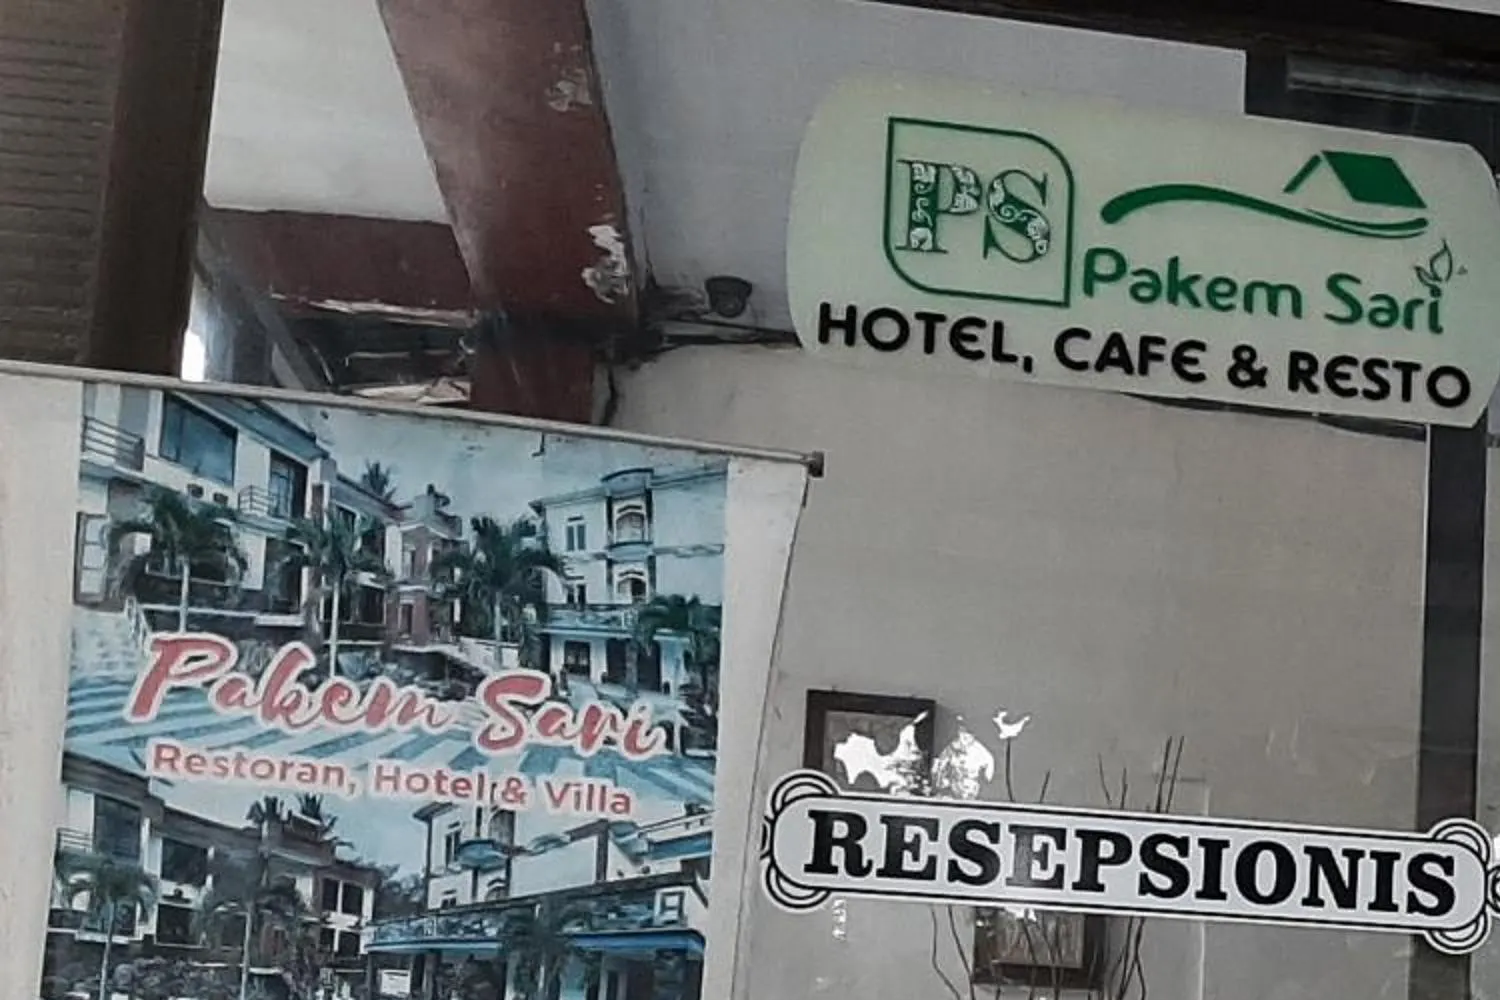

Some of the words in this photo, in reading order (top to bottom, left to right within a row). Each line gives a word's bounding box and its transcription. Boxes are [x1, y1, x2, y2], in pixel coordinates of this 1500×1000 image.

[895, 158, 1052, 263] PS
[1083, 247, 1303, 319] Pakem
[1324, 271, 1445, 335] Sari
[819, 300, 1036, 373] HOTEL,
[1055, 327, 1207, 383] CAFE
[1227, 345, 1268, 388] &
[1288, 351, 1471, 408] RESTO
[130, 635, 452, 731] Pakem
[476, 673, 662, 756] Sari
[153, 743, 354, 795] Restoran,
[374, 765, 484, 800] Hotel
[500, 776, 527, 804] &
[545, 780, 632, 815] Villa
[803, 808, 1459, 918] RESEPSIONIS
